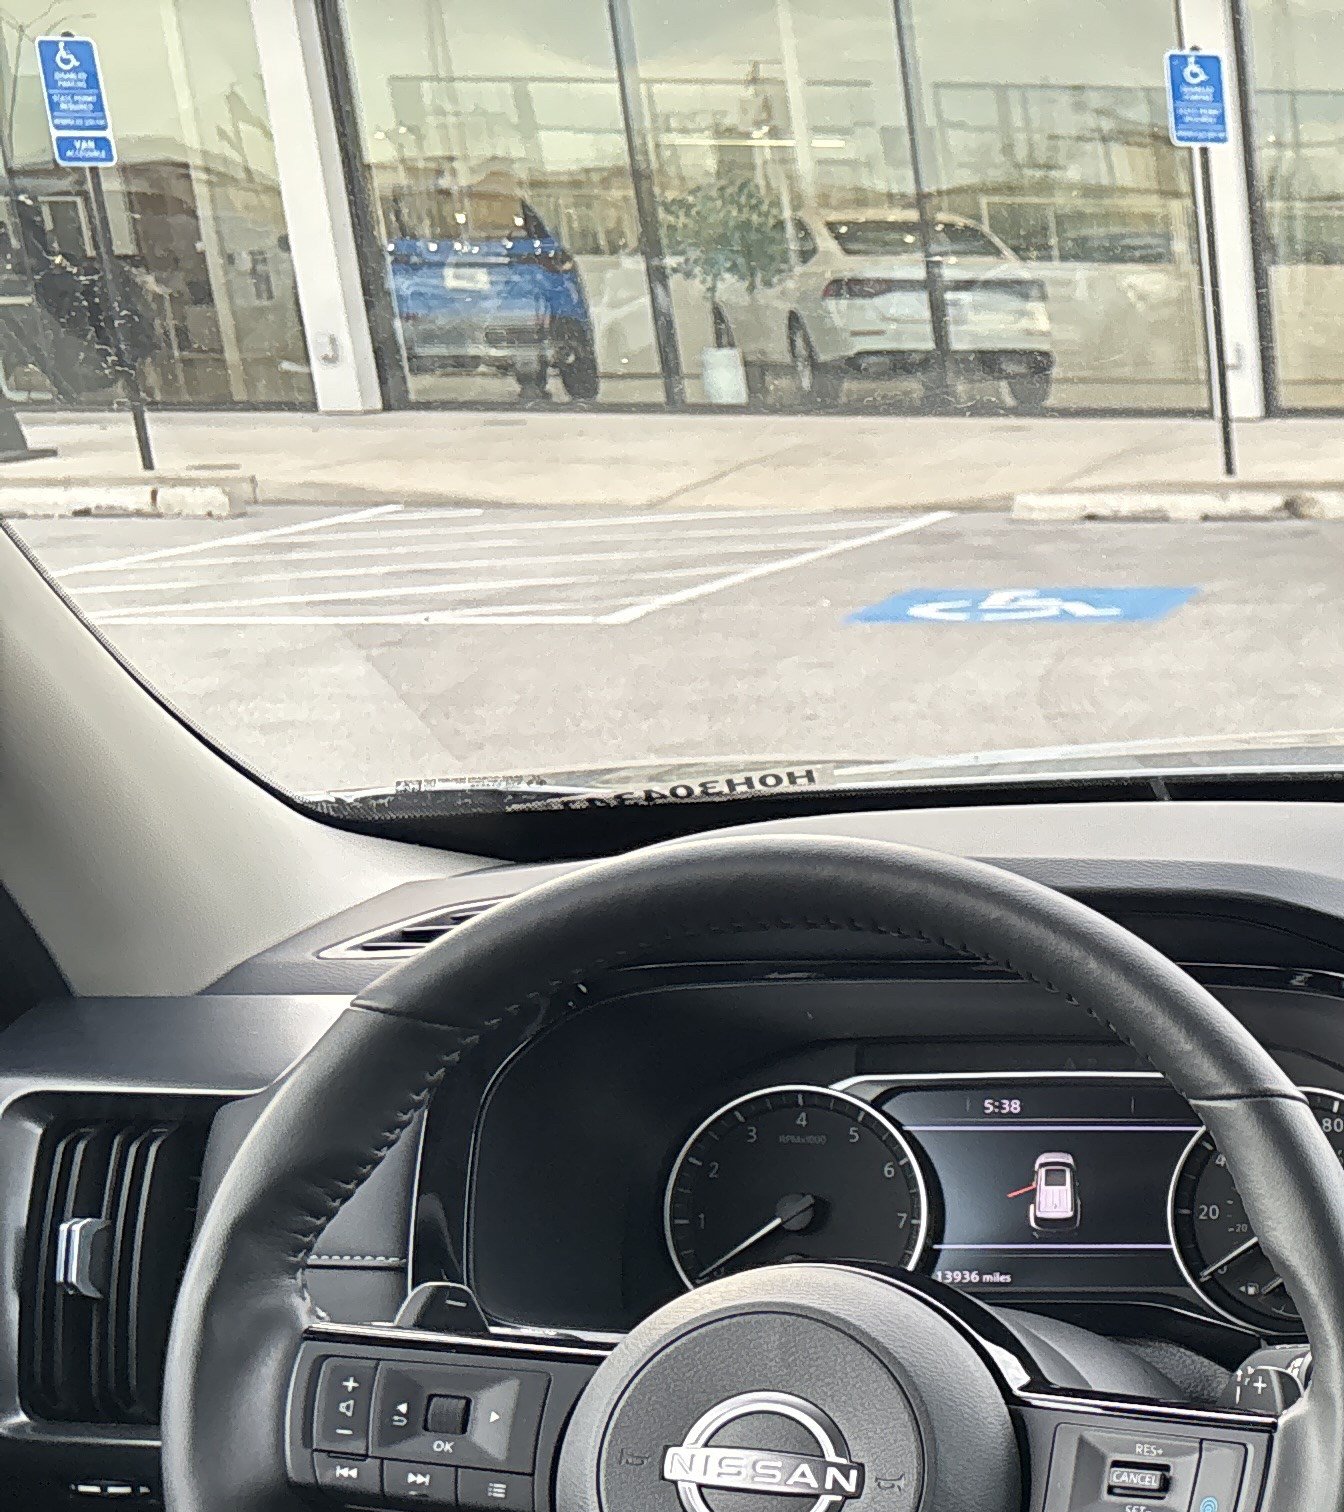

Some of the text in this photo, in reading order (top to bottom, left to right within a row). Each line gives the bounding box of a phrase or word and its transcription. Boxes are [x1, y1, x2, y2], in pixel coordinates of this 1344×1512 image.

[983, 1099, 1021, 1114] 5:38
[795, 1111, 808, 1128] 4
[1321, 1117, 1344, 1133] 80
[746, 1126, 757, 1143] 3
[848, 1126, 860, 1143] 5
[708, 1161, 720, 1179] 2
[883, 1161, 895, 1178] 6
[896, 1212, 907, 1229] 7
[1199, 1204, 1220, 1220] 20
[698, 1212, 706, 1230] 1
[936, 1270, 1012, 1284] 13936 miles
[432, 1440, 454, 1453] OK
[669, 1451, 858, 1493] NISSAN
[1111, 1470, 1158, 1487] CANCEL
